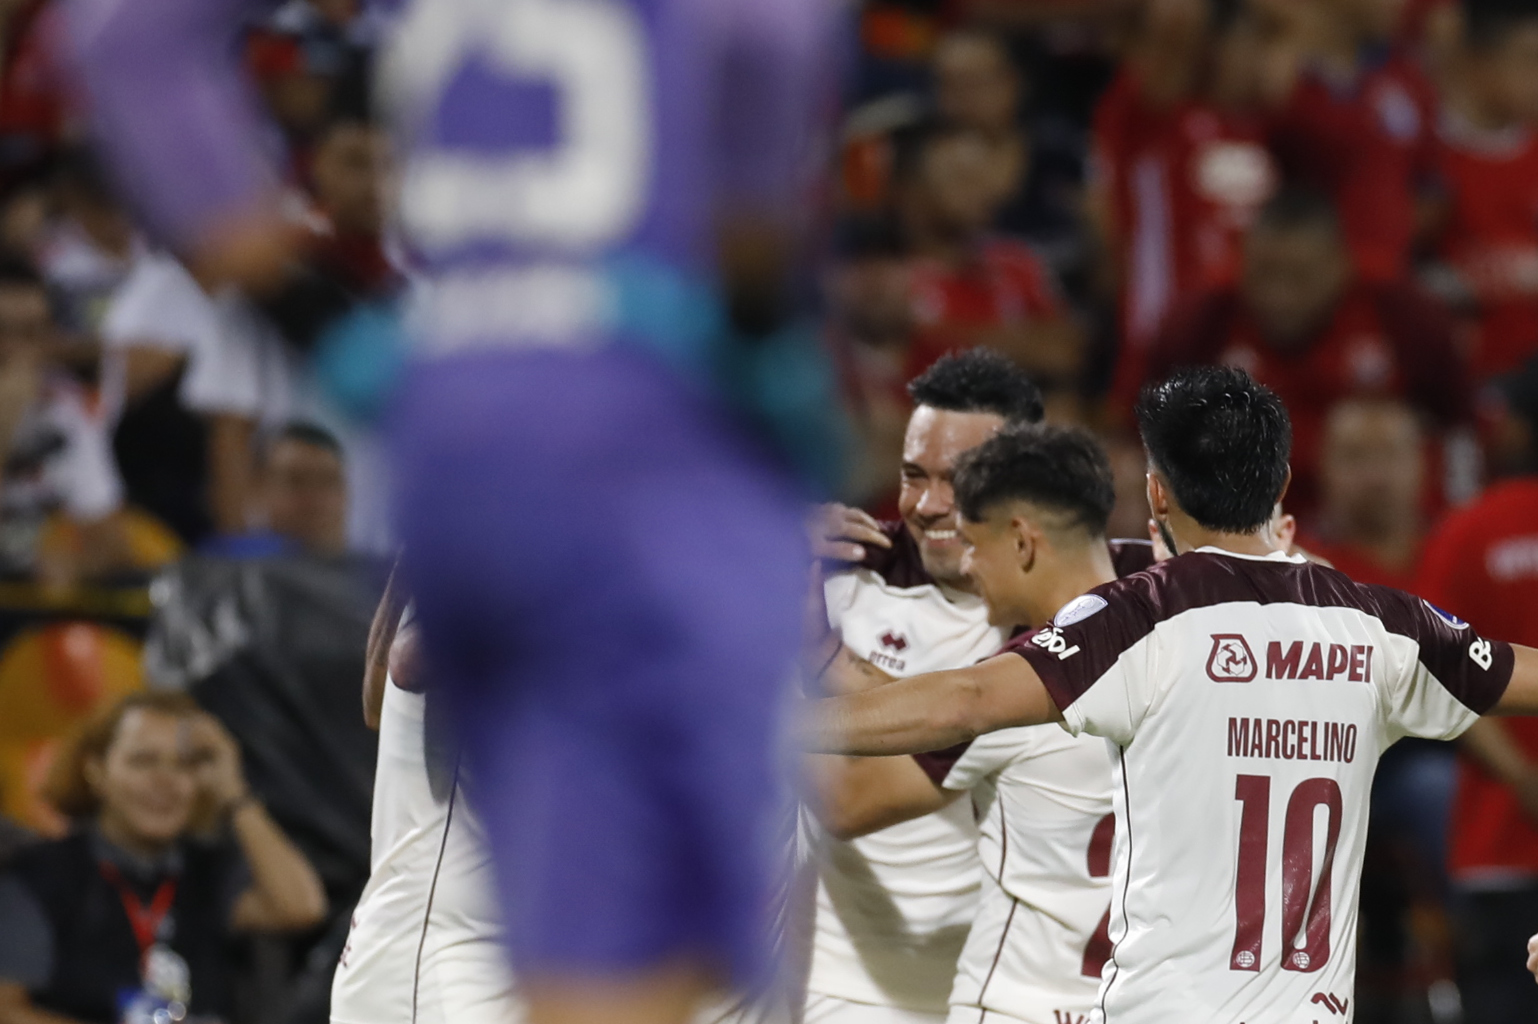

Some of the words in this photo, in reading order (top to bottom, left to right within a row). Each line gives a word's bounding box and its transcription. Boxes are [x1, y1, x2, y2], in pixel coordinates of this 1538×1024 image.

[1265, 640, 1374, 683] MAPEI
[1227, 717, 1358, 764] MARCELINO
[1229, 773, 1342, 973] 10
